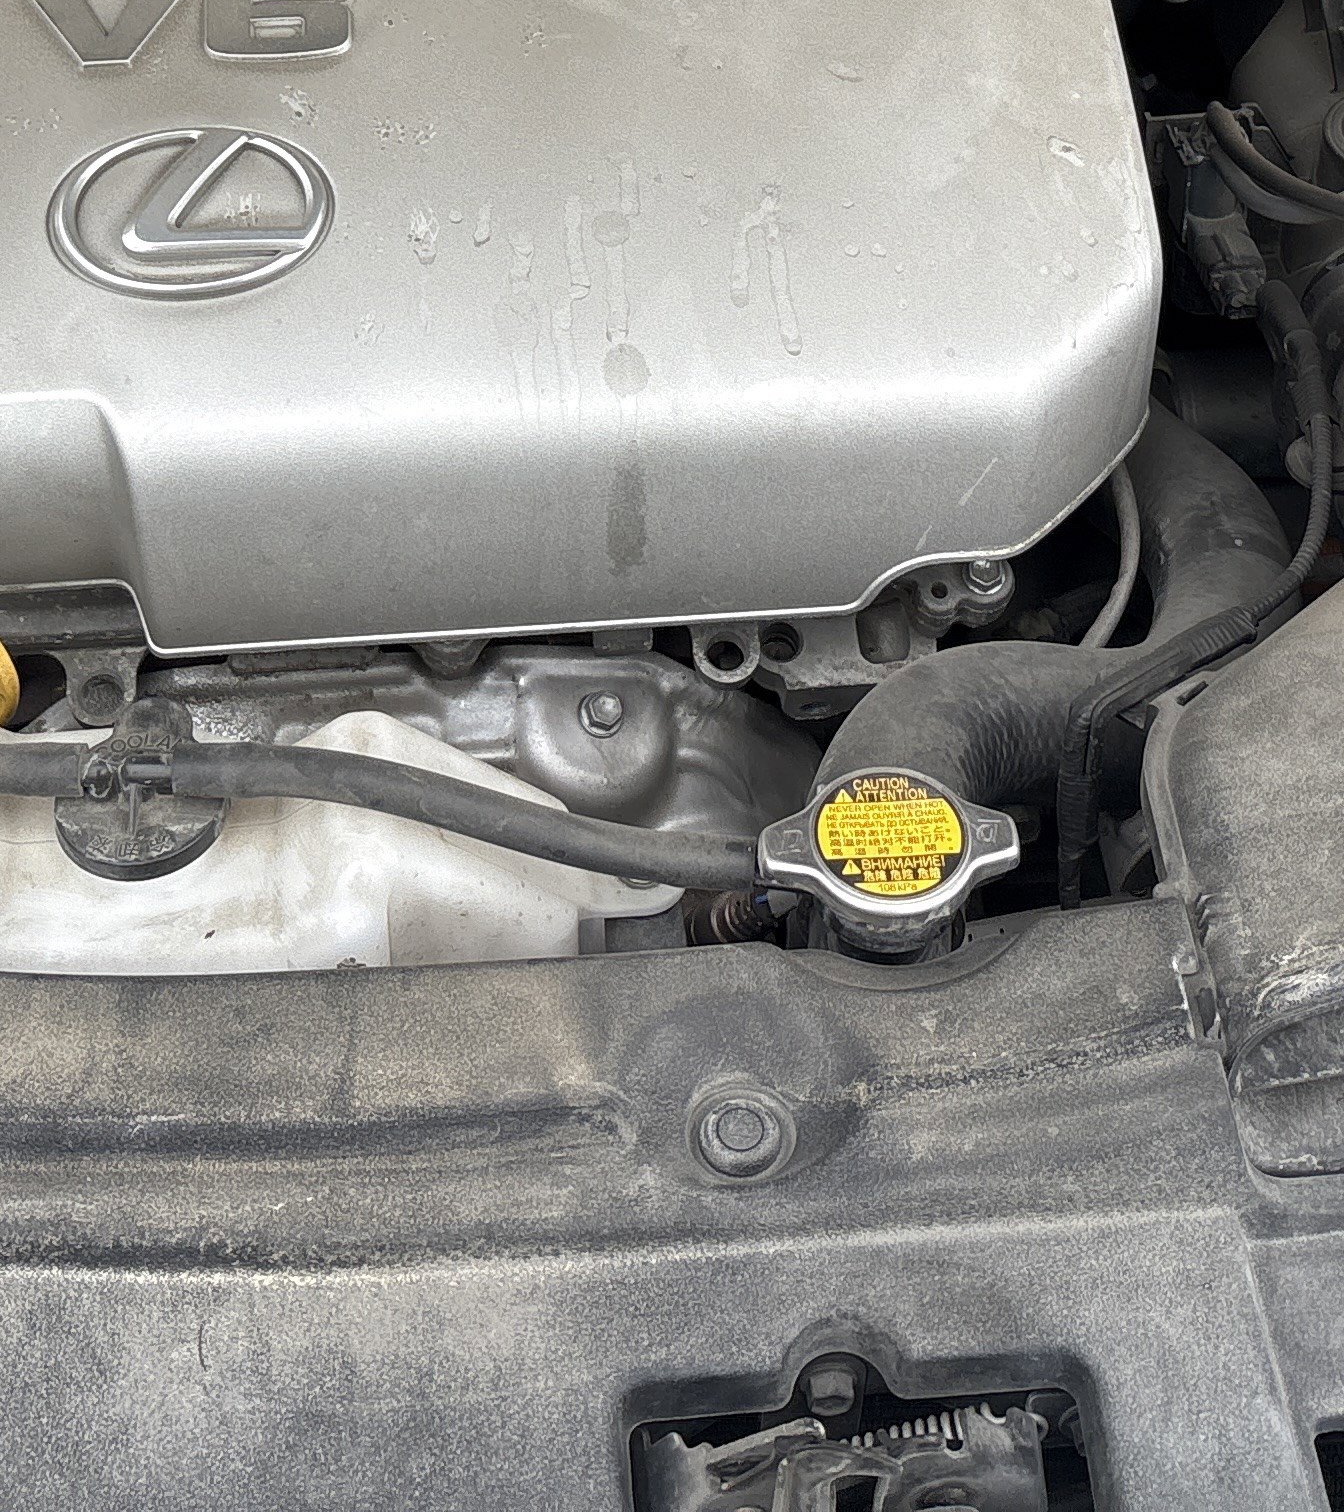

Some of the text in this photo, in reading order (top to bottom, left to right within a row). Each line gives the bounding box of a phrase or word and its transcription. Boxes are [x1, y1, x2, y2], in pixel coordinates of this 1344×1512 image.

[853, 777, 909, 791] CAUTION
[855, 788, 928, 803] ATTENTION
[829, 804, 861, 813] NEVER
[864, 804, 890, 812] OPEN
[894, 802, 922, 811] WHEN
[826, 813, 838, 821] NE
[861, 855, 946, 870] ВНИМАНИЕ!
